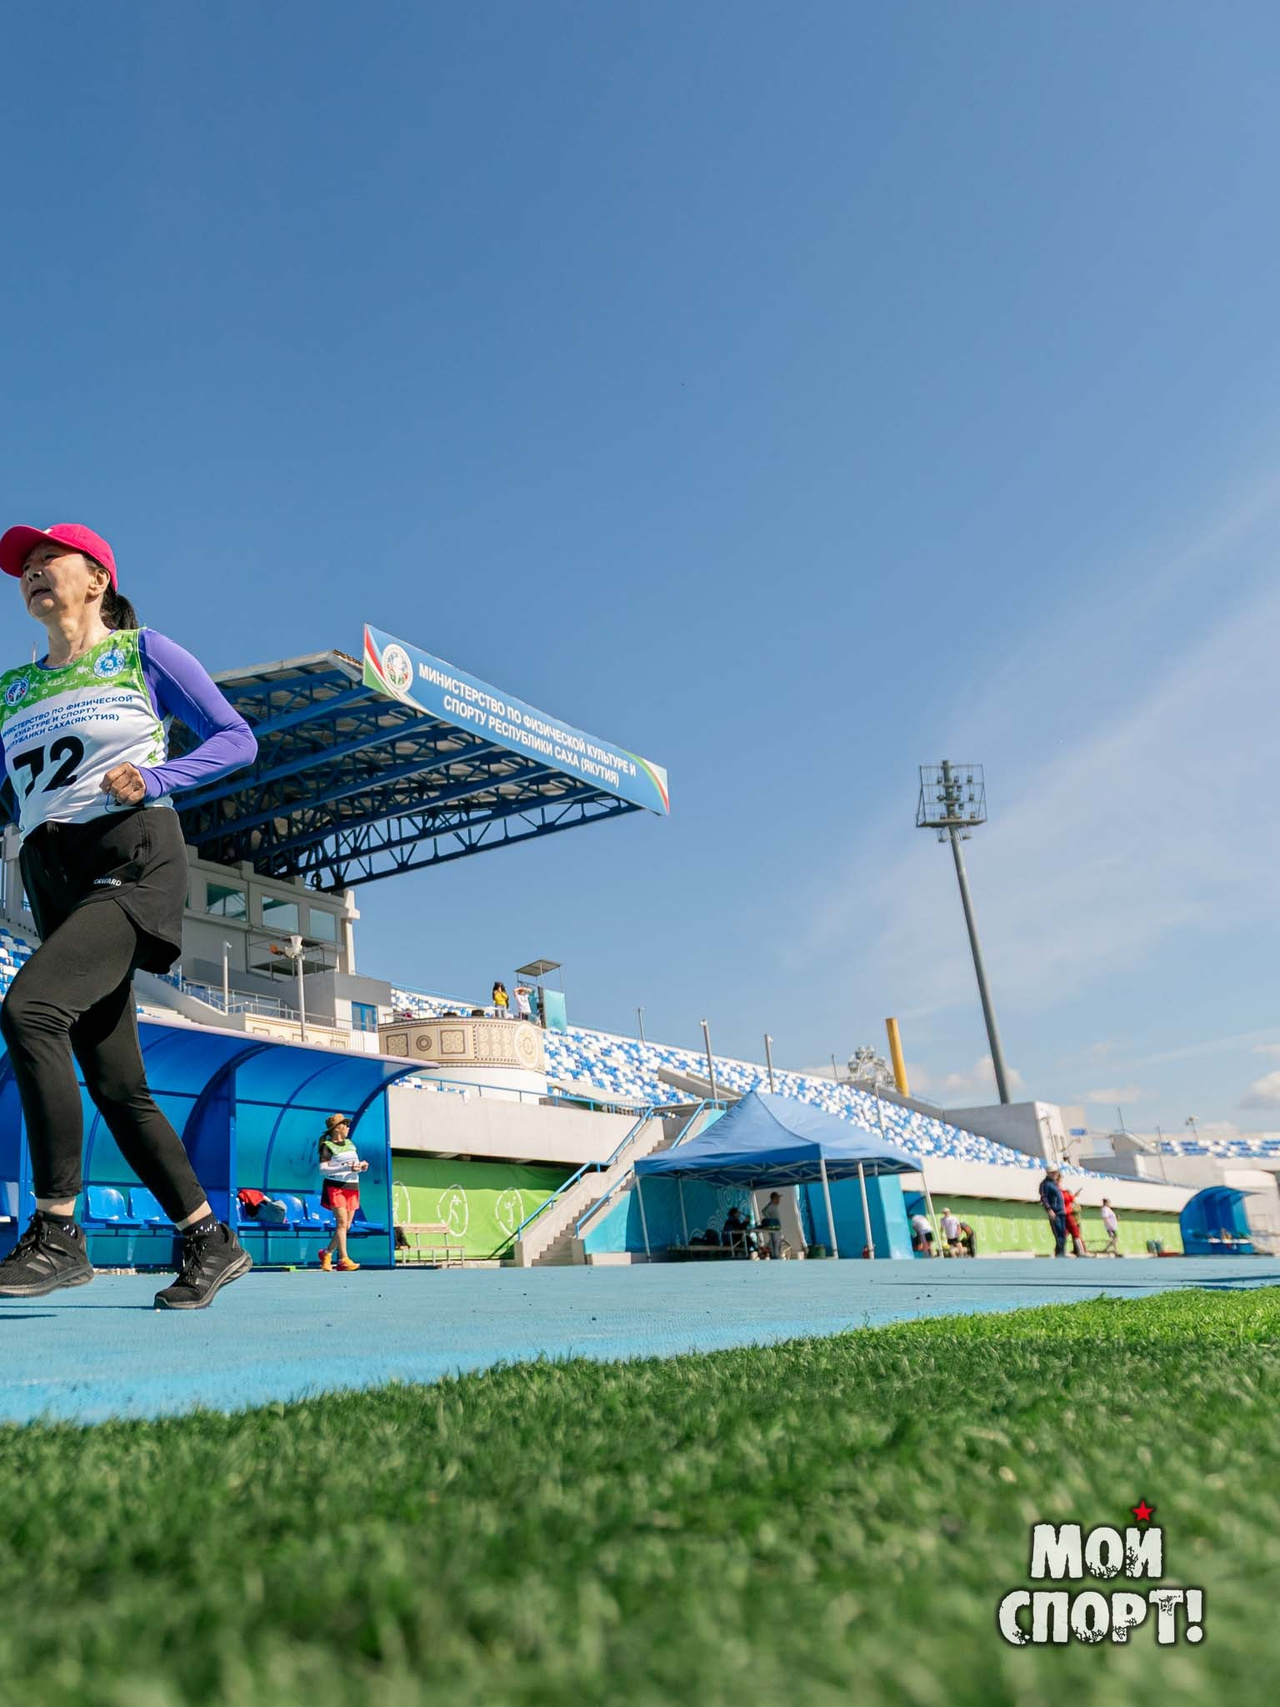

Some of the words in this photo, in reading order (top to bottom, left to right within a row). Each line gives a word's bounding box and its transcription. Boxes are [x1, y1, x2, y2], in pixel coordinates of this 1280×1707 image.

[14, 718, 53, 739] КУЛЬТУРЕ
[61, 707, 99, 719] СПОРТУ
[51, 706, 64, 716] ПО
[66, 694, 133, 711] ФИЗИЧЕСКОЙ
[418, 662, 506, 716] МИНИСТЕРСТВО
[506, 705, 522, 724] ПО
[523, 714, 586, 753] ФИЗИЧЕСКОЙ
[586, 743, 629, 773] КУЛЬТУРЕ
[629, 763, 637, 777] И
[12, 735, 84, 800] 72
[443, 695, 488, 726] СПОРТУ
[488, 715, 553, 756] РЕСПУБЛИКИ
[554, 745, 580, 768] САХА
[580, 756, 620, 788] (ЯКУТИЯ)
